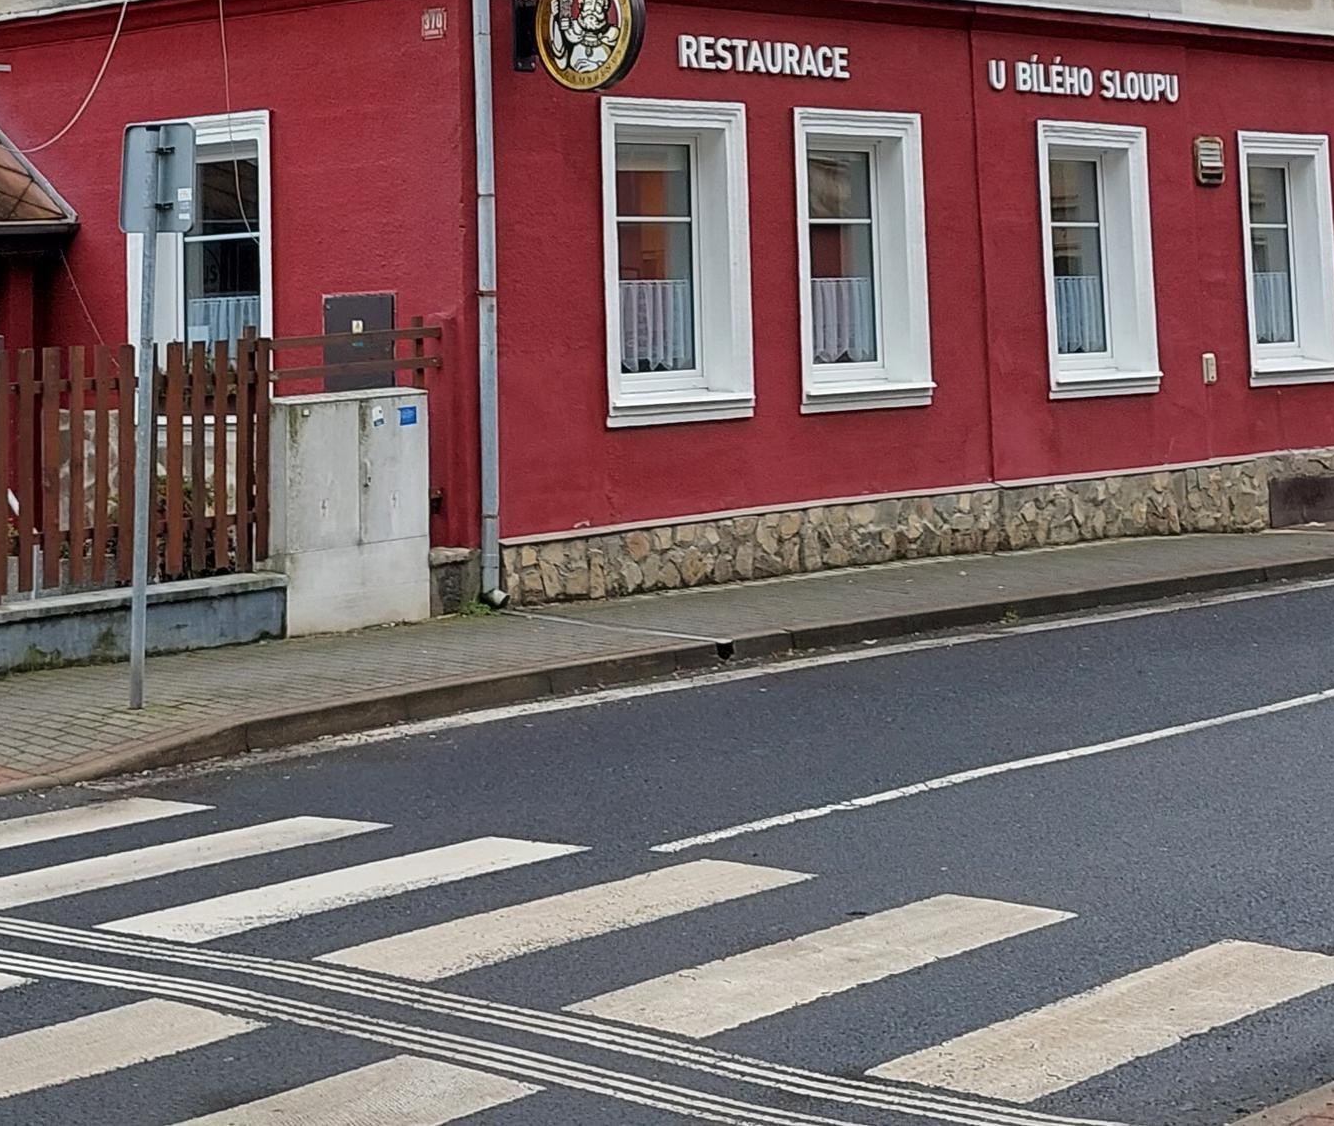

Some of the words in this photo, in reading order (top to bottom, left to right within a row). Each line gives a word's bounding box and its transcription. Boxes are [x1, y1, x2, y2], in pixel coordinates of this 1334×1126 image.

[678, 34, 850, 80] RESTAURACE
[988, 59, 1007, 89] U
[1015, 53, 1094, 96] BÍLÉHO
[1101, 69, 1179, 103] SLOUPU
